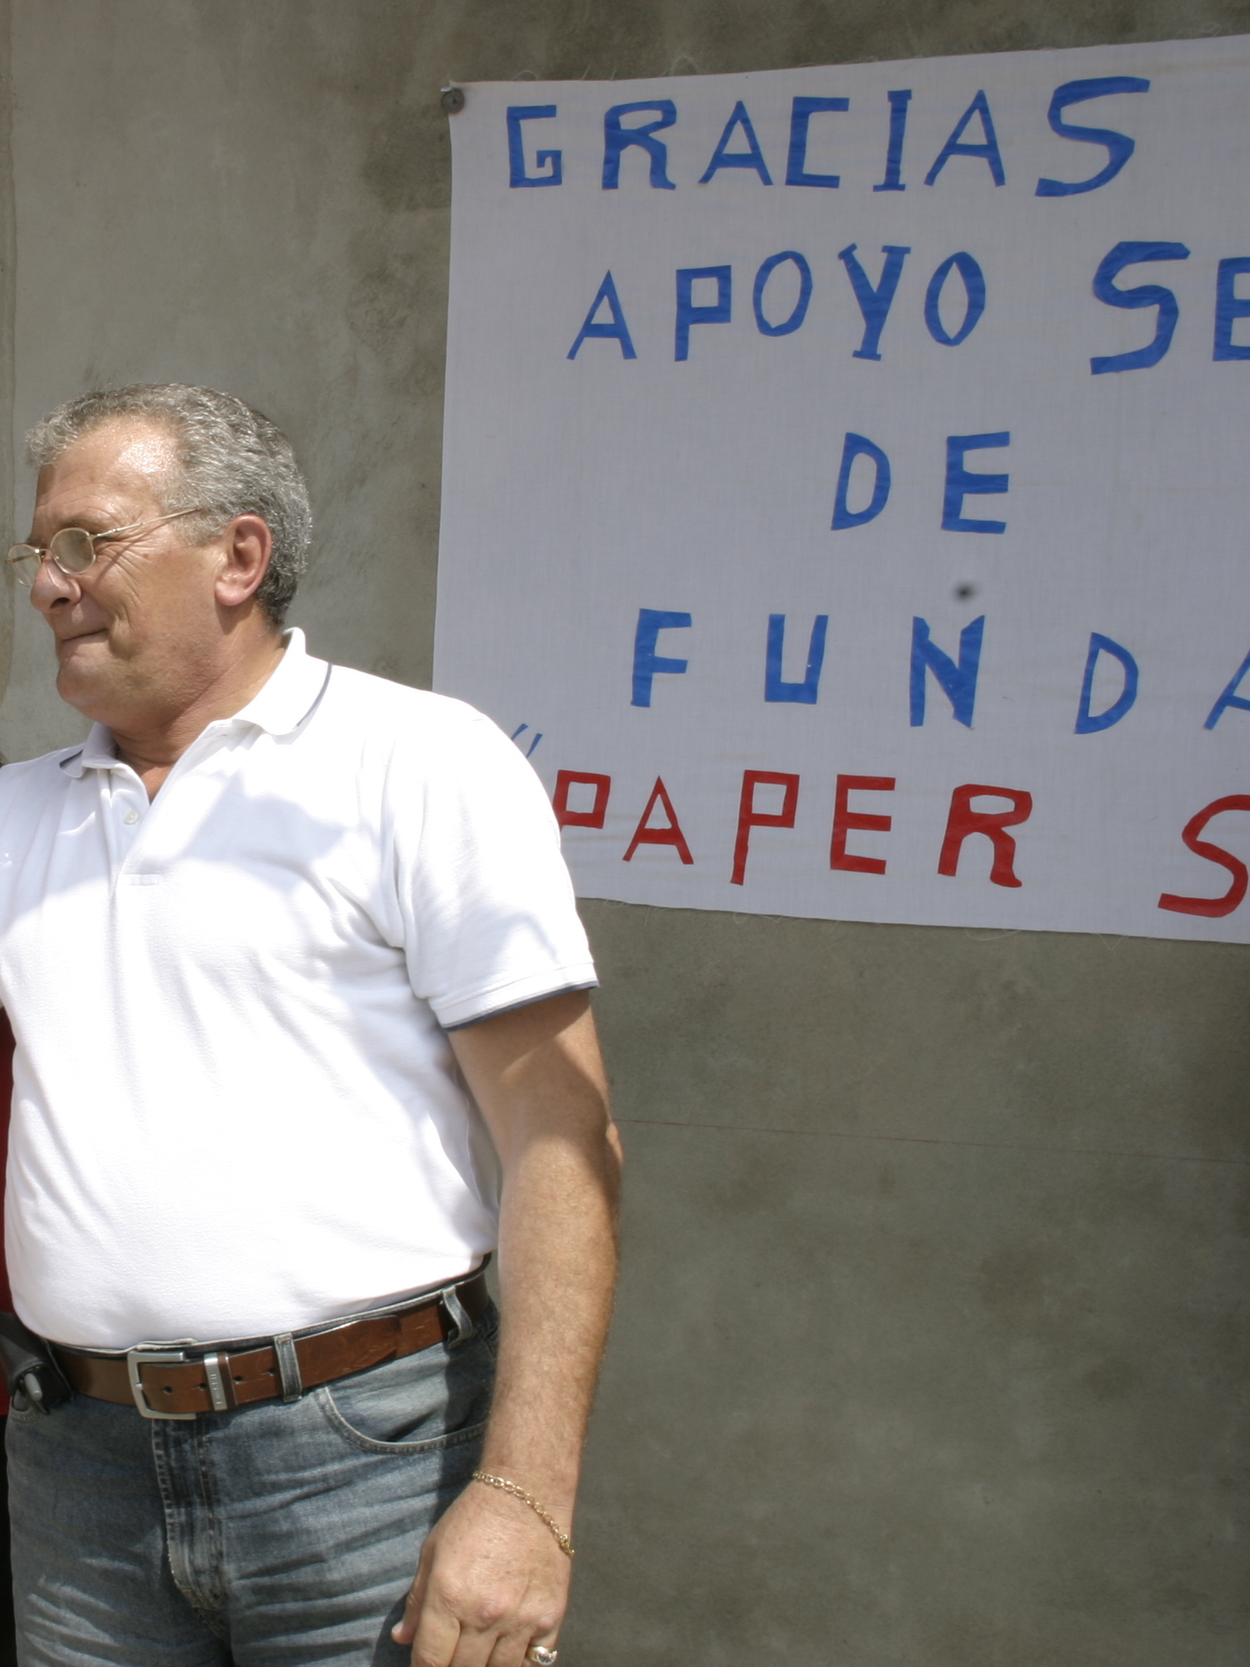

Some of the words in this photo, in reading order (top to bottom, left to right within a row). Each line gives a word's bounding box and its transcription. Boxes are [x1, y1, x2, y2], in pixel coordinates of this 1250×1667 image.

[507, 76, 1151, 197] GRACIAS
[567, 243, 987, 361] APOYO
[830, 432, 1012, 534] DE
